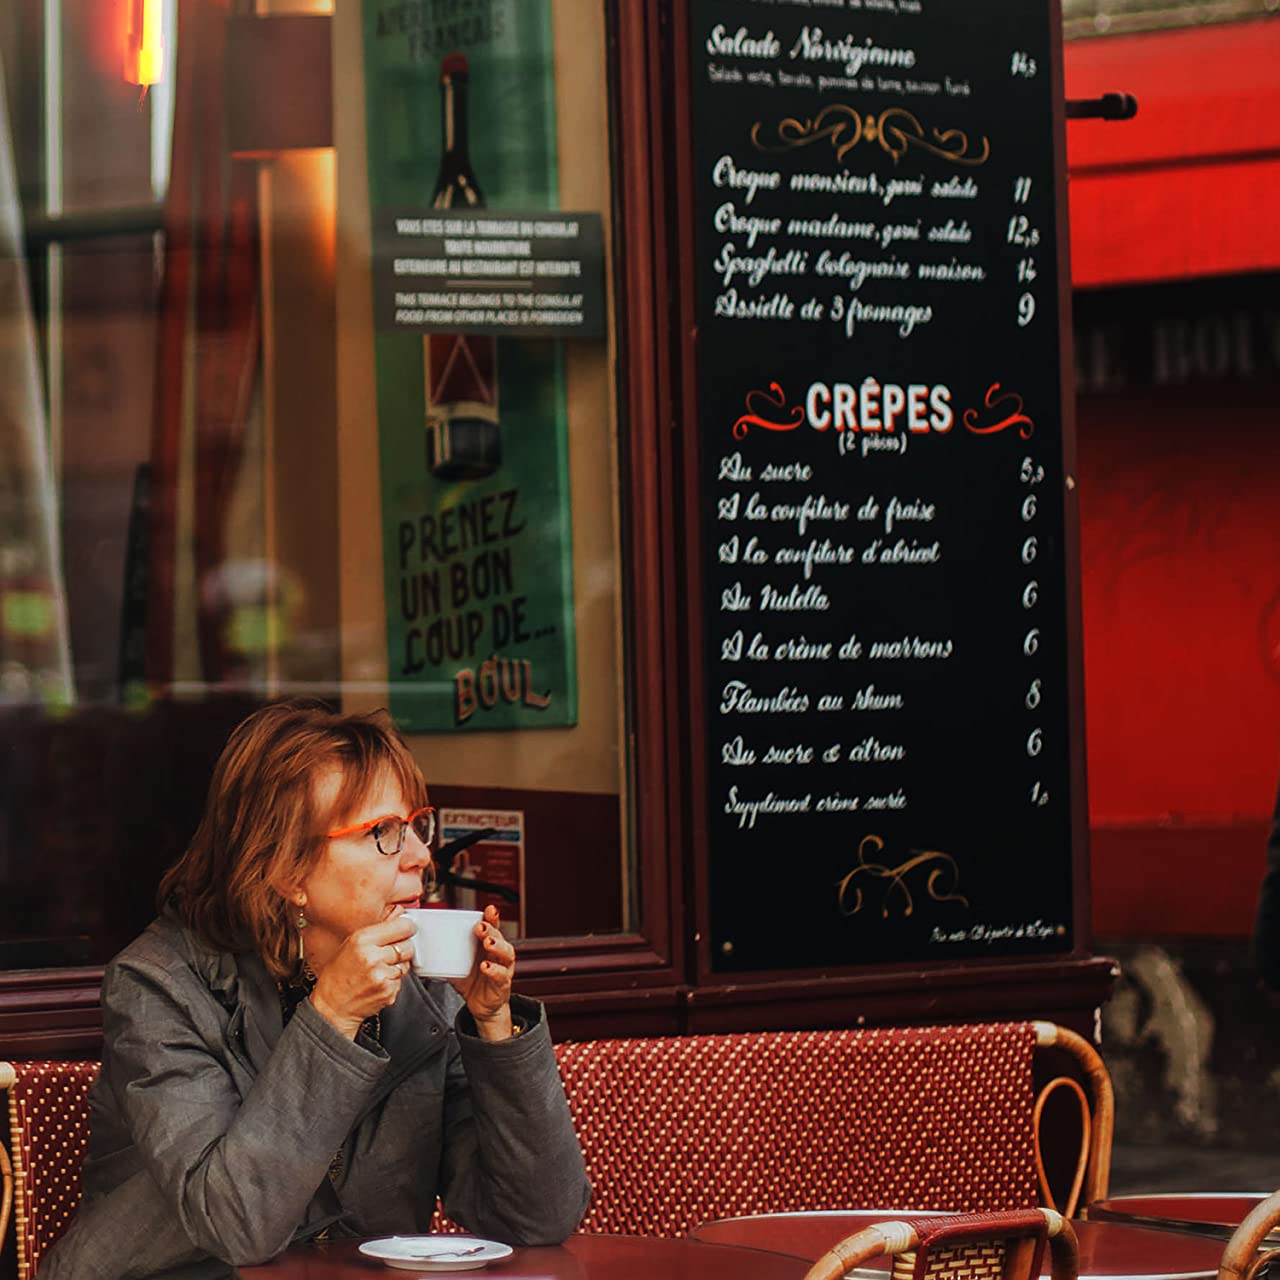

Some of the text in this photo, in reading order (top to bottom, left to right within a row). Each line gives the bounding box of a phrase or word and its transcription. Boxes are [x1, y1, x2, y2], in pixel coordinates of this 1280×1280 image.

[706, 23, 780, 58] Salade
[712, 155, 781, 205] Croque
[1014, 176, 1032, 203] 11
[714, 201, 782, 249] Croque
[713, 242, 809, 288] Spaghetti
[918, 257, 986, 281] maison
[715, 288, 1036, 339] Assiette de 3 fromages 9
[806, 376, 954, 433] CRÊPES
[718, 452, 752, 482] Au
[760, 459, 813, 482] sucre
[397, 489, 526, 569] PRENEZ
[744, 494, 769, 521] la
[771, 495, 850, 536] confiture
[857, 496, 880, 521] de
[885, 496, 936, 534] fraise
[1022, 494, 1037, 522] 6
[743, 536, 769, 564] la
[775, 538, 854, 580] confiture
[1022, 536, 1038, 565] 6
[401, 548, 513, 620] UN BON
[720, 580, 1038, 611] Au Nutella 6
[402, 613, 484, 675] COUP
[747, 633, 769, 659] la
[774, 636, 832, 660] crème
[838, 635, 862, 659] de
[869, 637, 953, 660] marrons
[1023, 628, 1040, 657] 6
[453, 655, 552, 726] BOUL
[720, 678, 1041, 715] Flambées au rhum 8
[721, 735, 756, 766] Au
[762, 742, 814, 765] sucre
[849, 735, 906, 762] citron
[1026, 727, 1042, 758] 6
[815, 794, 859, 811] crème
